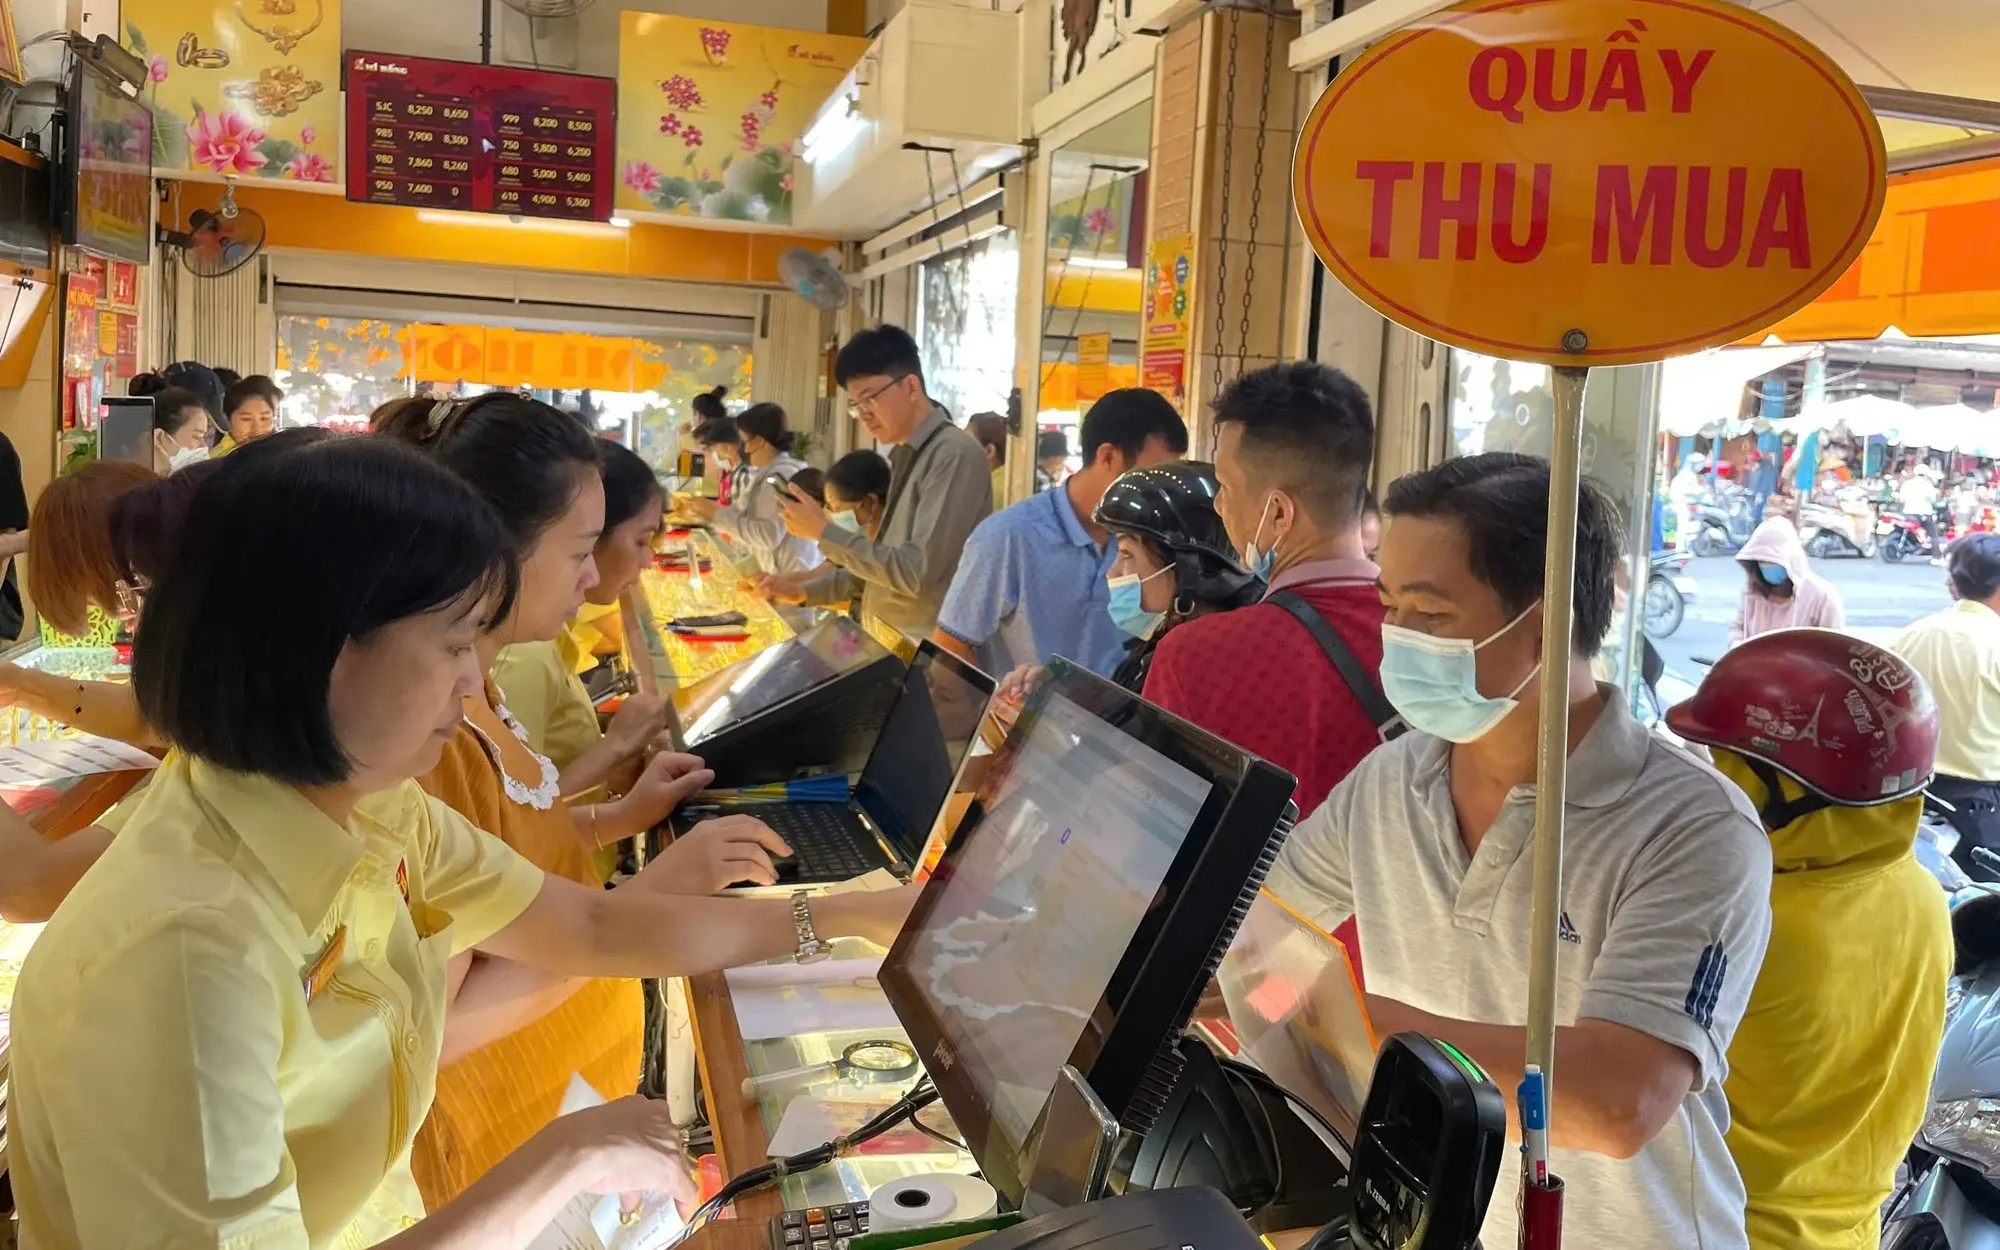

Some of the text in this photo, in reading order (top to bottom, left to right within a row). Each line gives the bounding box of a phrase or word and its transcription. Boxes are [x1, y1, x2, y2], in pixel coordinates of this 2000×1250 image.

[1468, 18, 1717, 124] QUẦY
[375, 101, 393, 112] SJC
[407, 104, 433, 116] 8,250
[502, 113, 592, 132] 999 8,200 8,500
[375, 127, 468, 145] 985 7,900 8,300
[502, 140, 591, 157] 750 5,800 6,200
[375, 154, 468, 172] 980 7,860 8,260
[501, 165, 591, 183] 680 5,000 5,400
[375, 180, 393, 190] 950
[407, 182, 432, 194] 7,600
[501, 191, 519, 201] 610
[532, 194, 556, 205] 4,900
[1356, 160, 1552, 264] THU
[1591, 164, 1812, 269] MUA
[1372, 1188, 1390, 1214] ZEBRA
